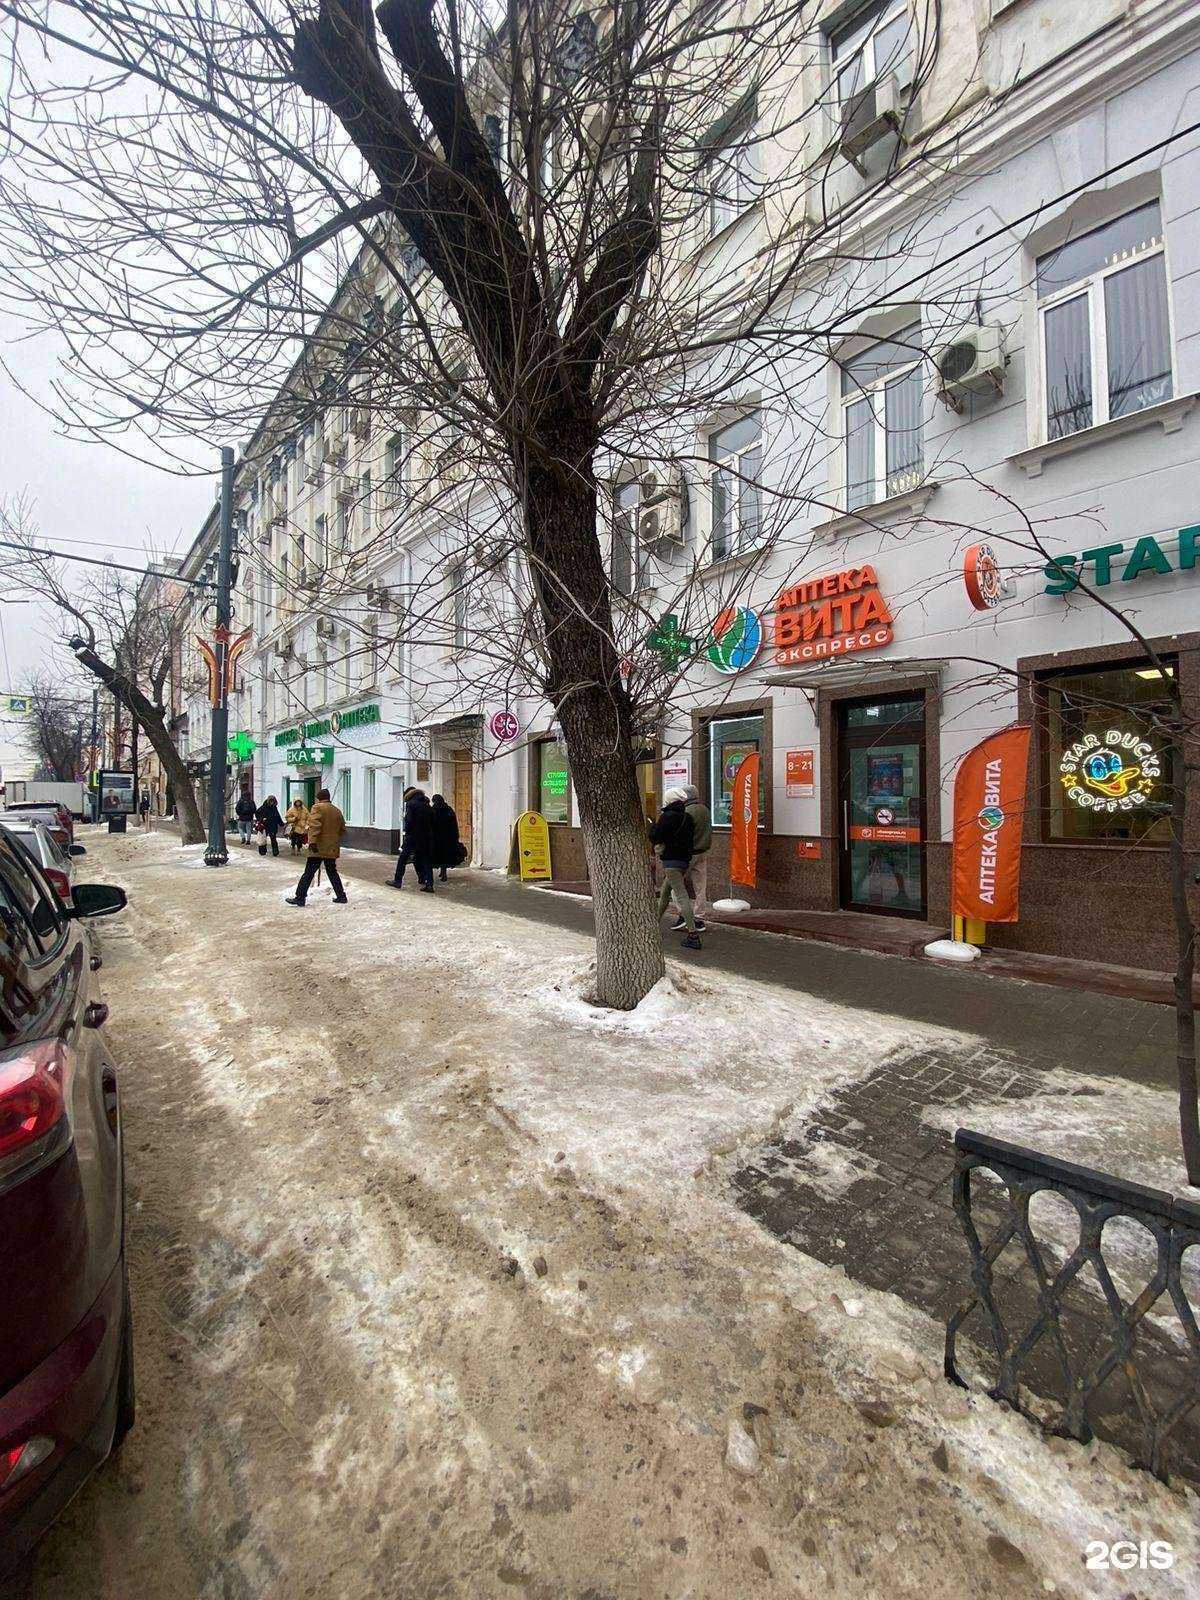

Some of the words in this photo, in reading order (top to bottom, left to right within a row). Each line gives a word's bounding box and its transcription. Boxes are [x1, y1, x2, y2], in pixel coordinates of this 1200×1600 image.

[775, 564, 878, 609] АПТЕКА
[774, 588, 894, 647] ВИТА
[776, 630, 888, 663] ЭКСПРЕСС
[1060, 734, 1100, 773] STAR
[1106, 730, 1161, 778] DUCKS
[744, 773, 752, 806] ВИТА
[984, 759, 1002, 806] ВИТА
[1068, 786, 1146, 813] COFFEE
[978, 831, 1001, 904] АПТЕКА
